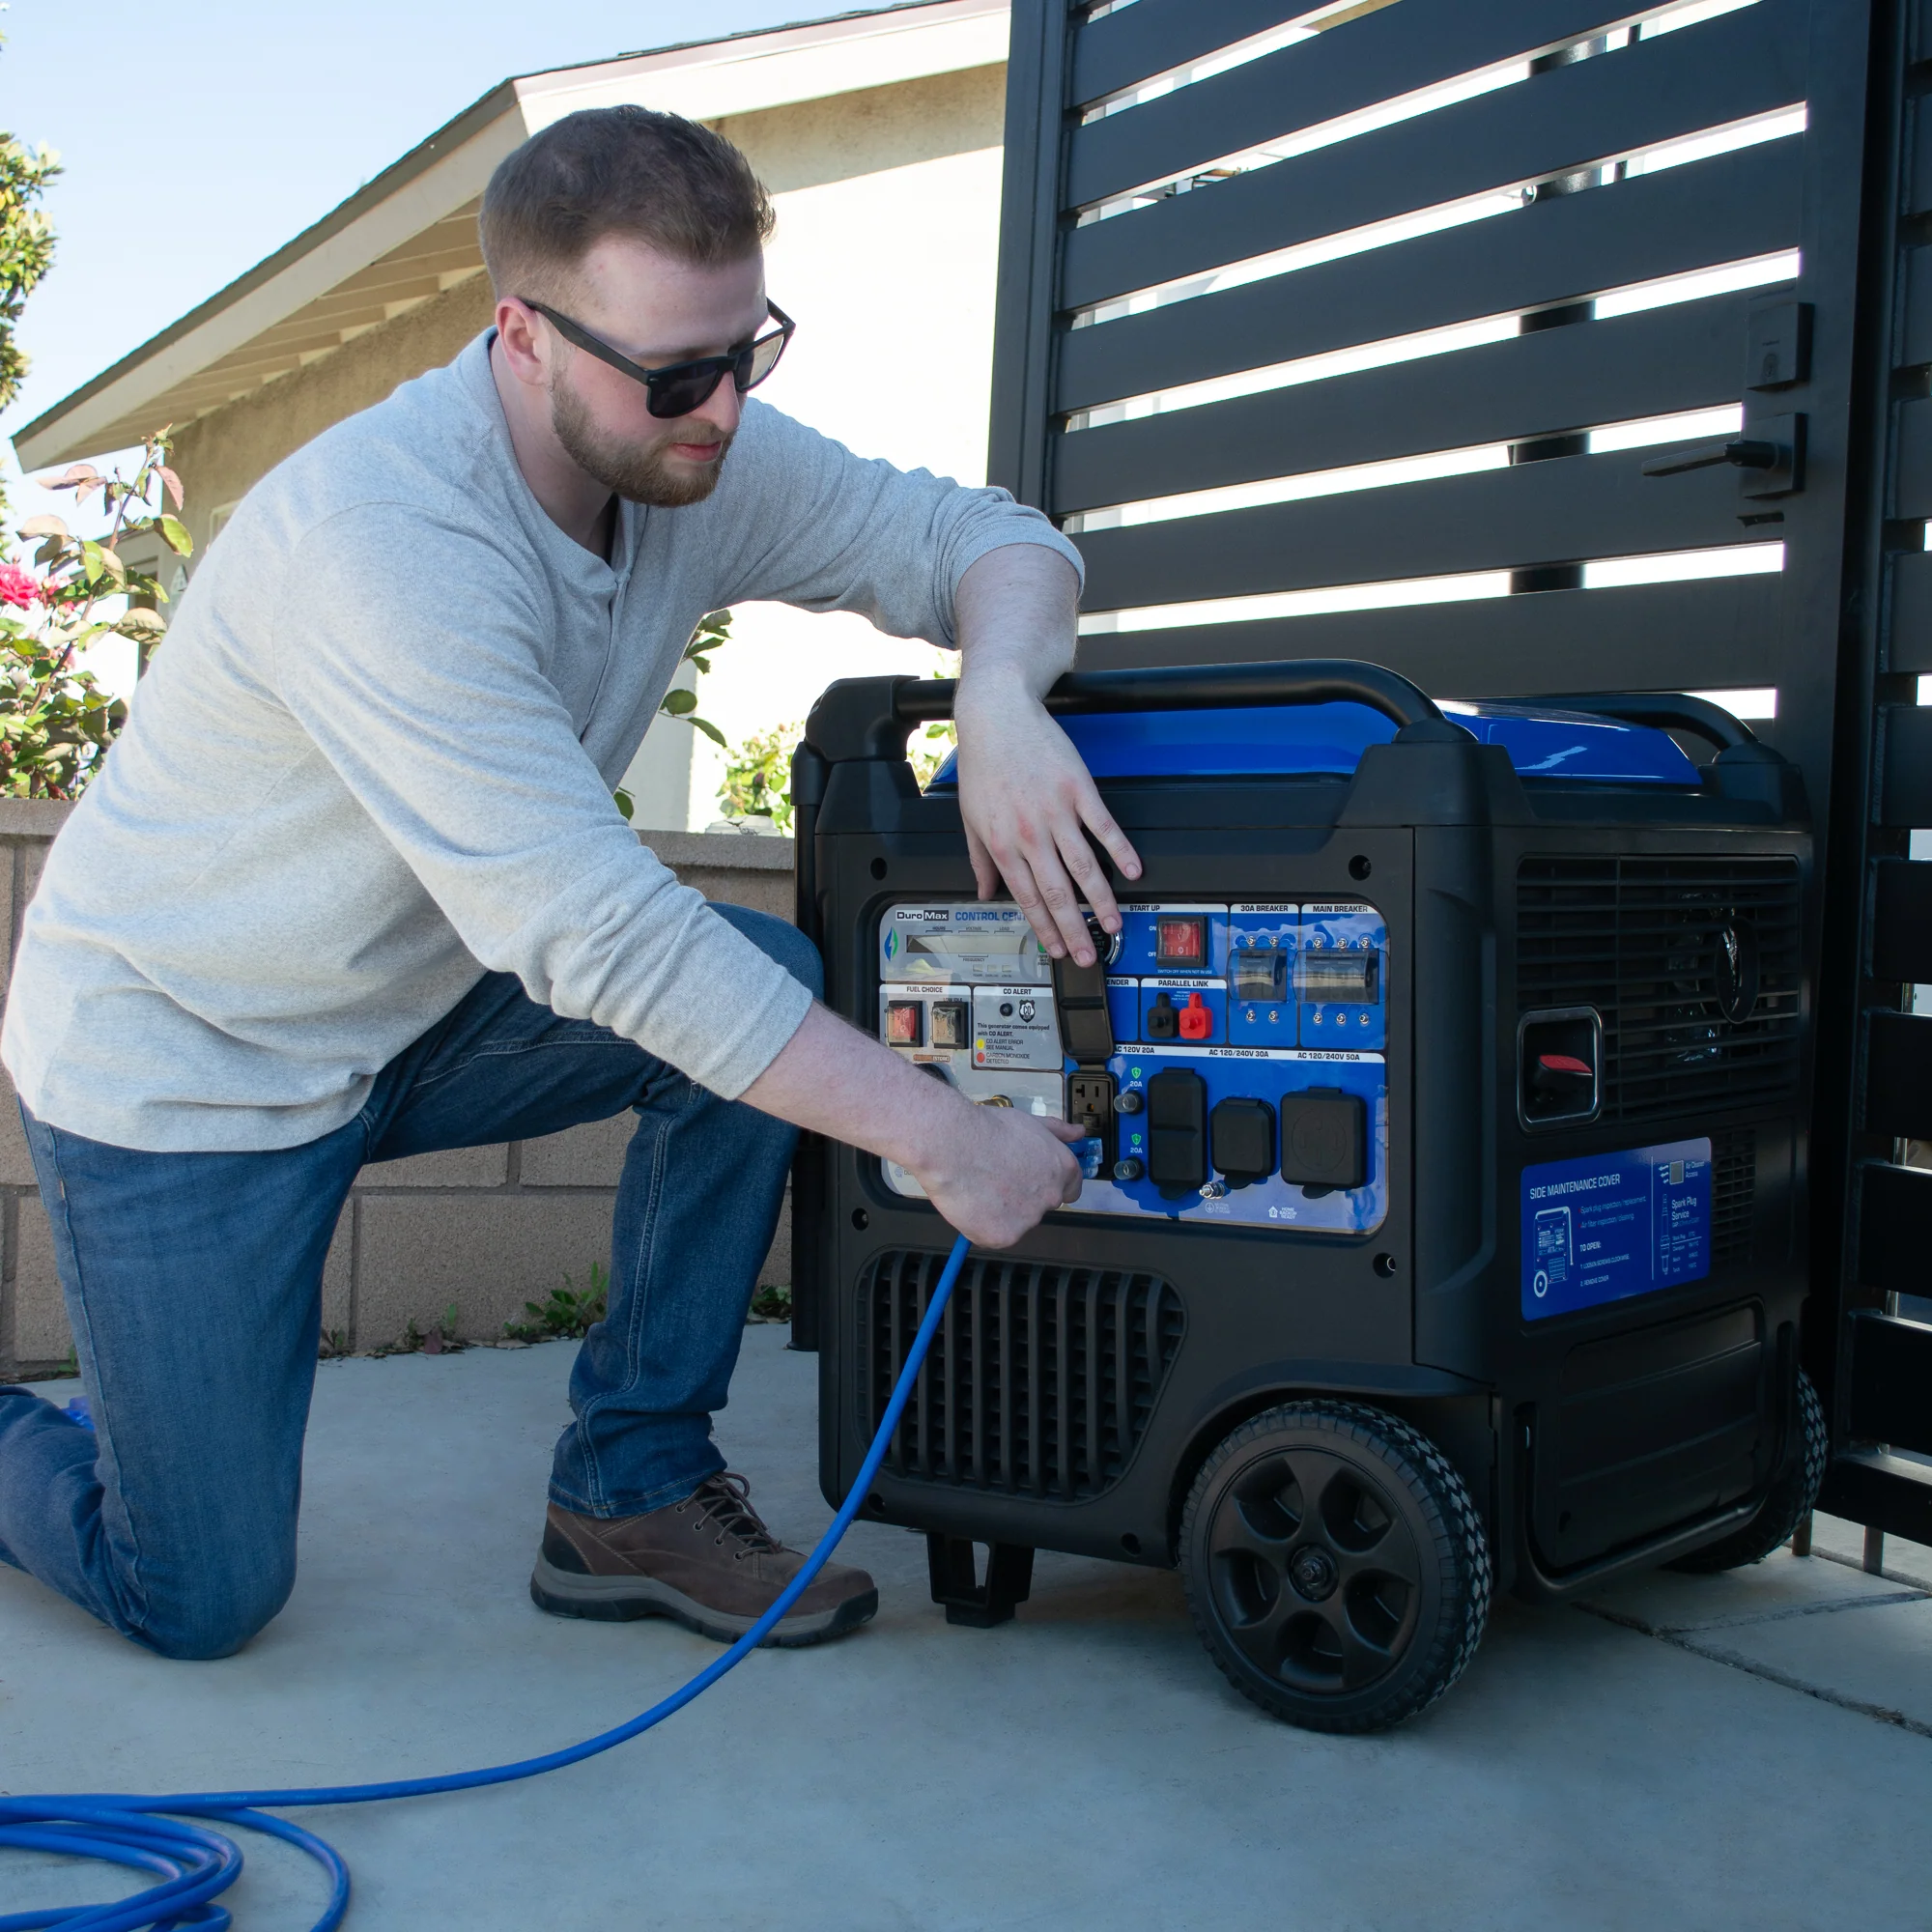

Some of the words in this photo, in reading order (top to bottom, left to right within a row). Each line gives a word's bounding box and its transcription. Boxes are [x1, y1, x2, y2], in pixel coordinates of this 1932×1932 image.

[896, 911, 948, 920] DuroMax
[955, 911, 1000, 921] CONTROL
[1023, 1005, 1031, 1014] CO
[1529, 1186, 1547, 1199] SIDE
[1547, 1178, 1597, 1196] MAINTENANCE
[1598, 1174, 1620, 1187] COVER
[1671, 1198, 1686, 1210] Spark
[1687, 1196, 1697, 1207] Plug
[1671, 1209, 1690, 1220] Service
[1579, 1243, 1586, 1252] TO
[1586, 1241, 1602, 1251] OPEN:
[1583, 1277, 1598, 1287] REMOVE
[1598, 1274, 1609, 1283] COVER
